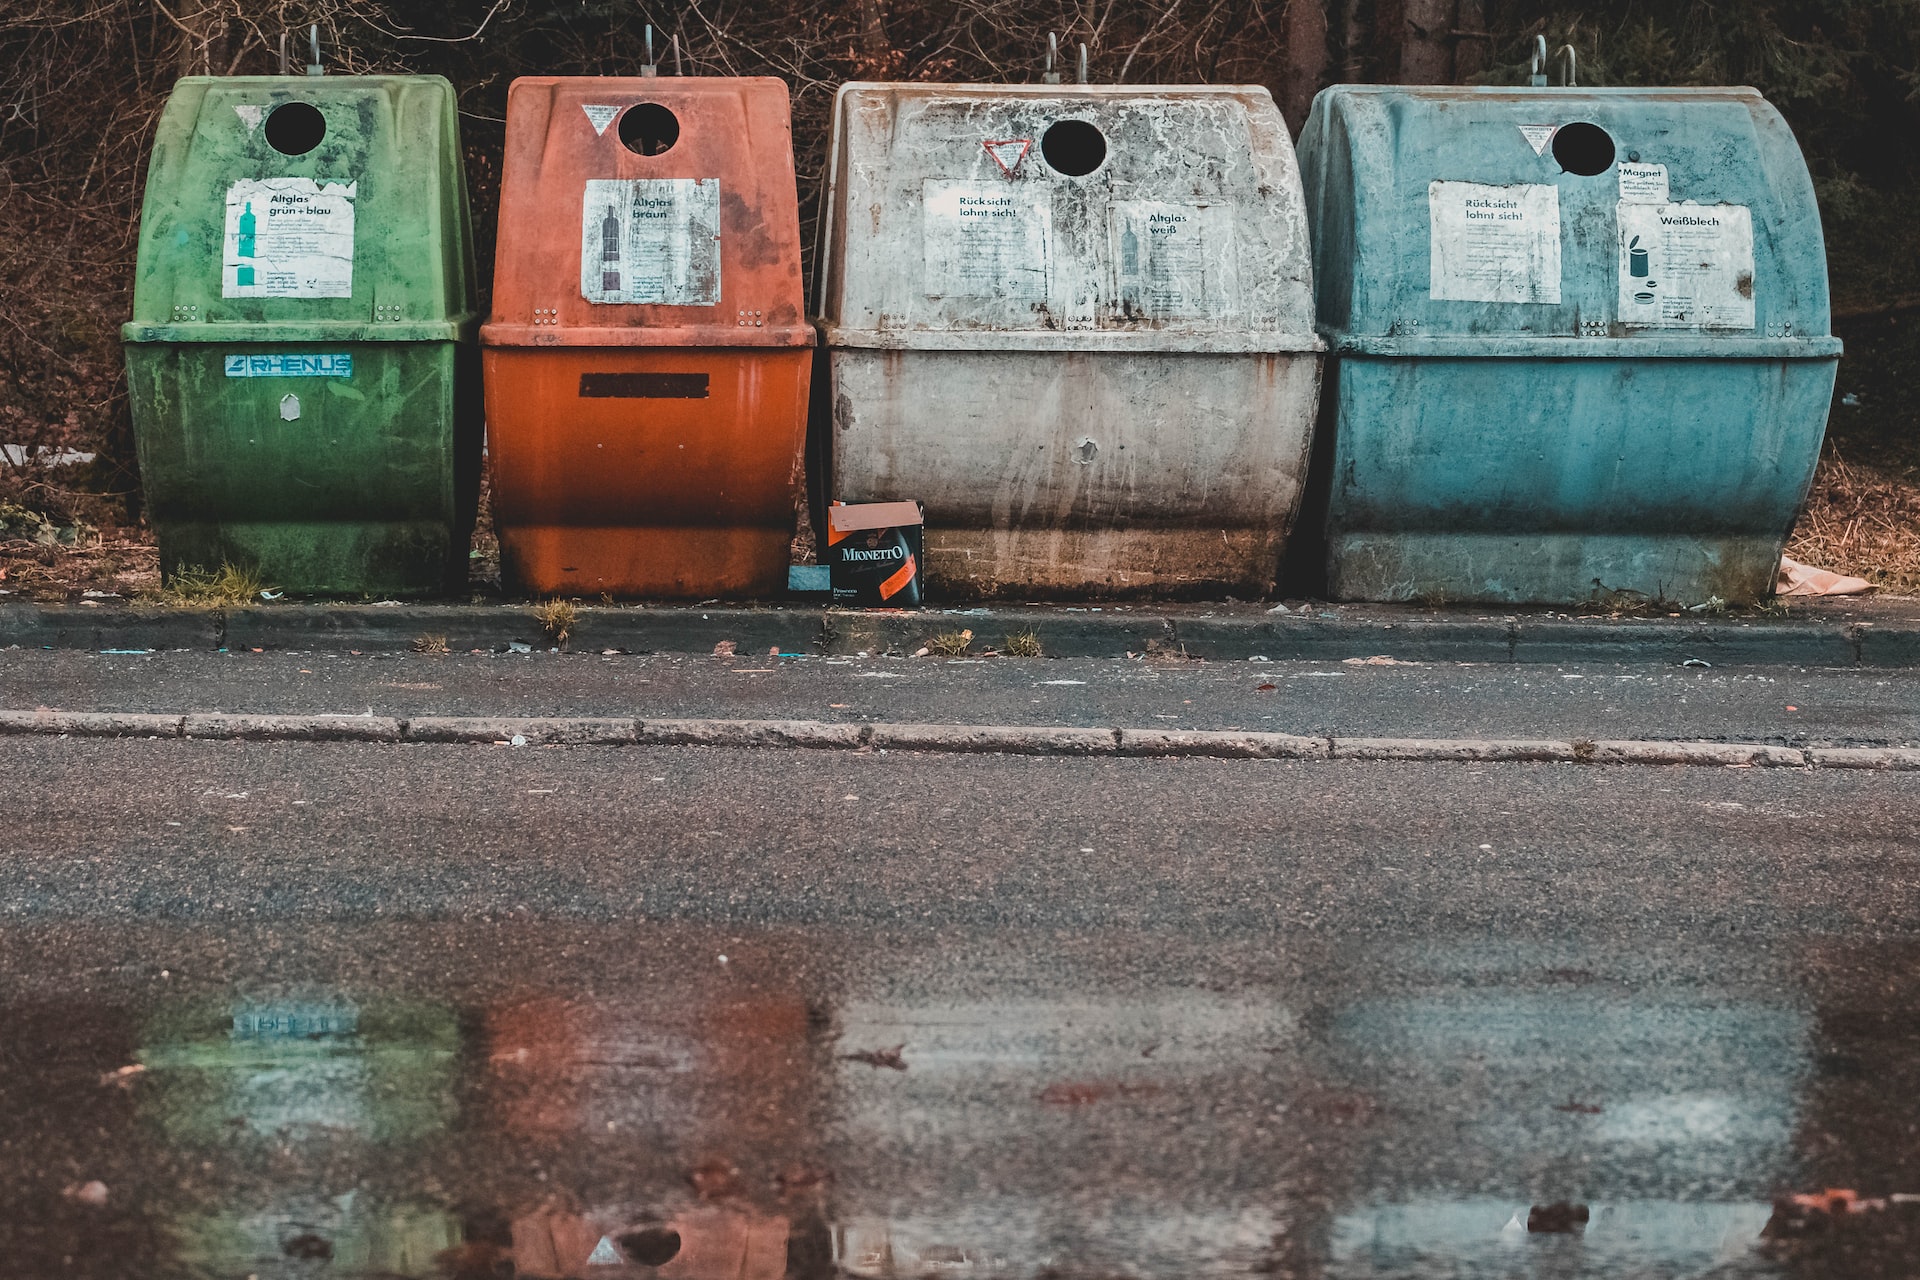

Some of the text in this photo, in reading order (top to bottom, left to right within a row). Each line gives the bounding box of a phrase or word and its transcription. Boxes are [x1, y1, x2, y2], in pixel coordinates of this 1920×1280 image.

[1623, 168, 1661, 178] Magnet
[270, 194, 309, 204] Altglas
[633, 197, 672, 208] Altglas
[960, 197, 1012, 206] Rücksicht
[1465, 199, 1518, 209] Rücksicht
[269, 205, 296, 217] grün
[306, 204, 332, 216] blau
[633, 209, 667, 219] braun
[960, 208, 1016, 218] lohnt sich!
[1466, 210, 1523, 221] lohnt sich!
[1149, 213, 1187, 224] Altglas
[1660, 216, 1720, 226] Weißblech
[1150, 225, 1177, 234] weiß
[251, 358, 350, 372] RHENUS
[842, 546, 903, 561] MIONETTO
